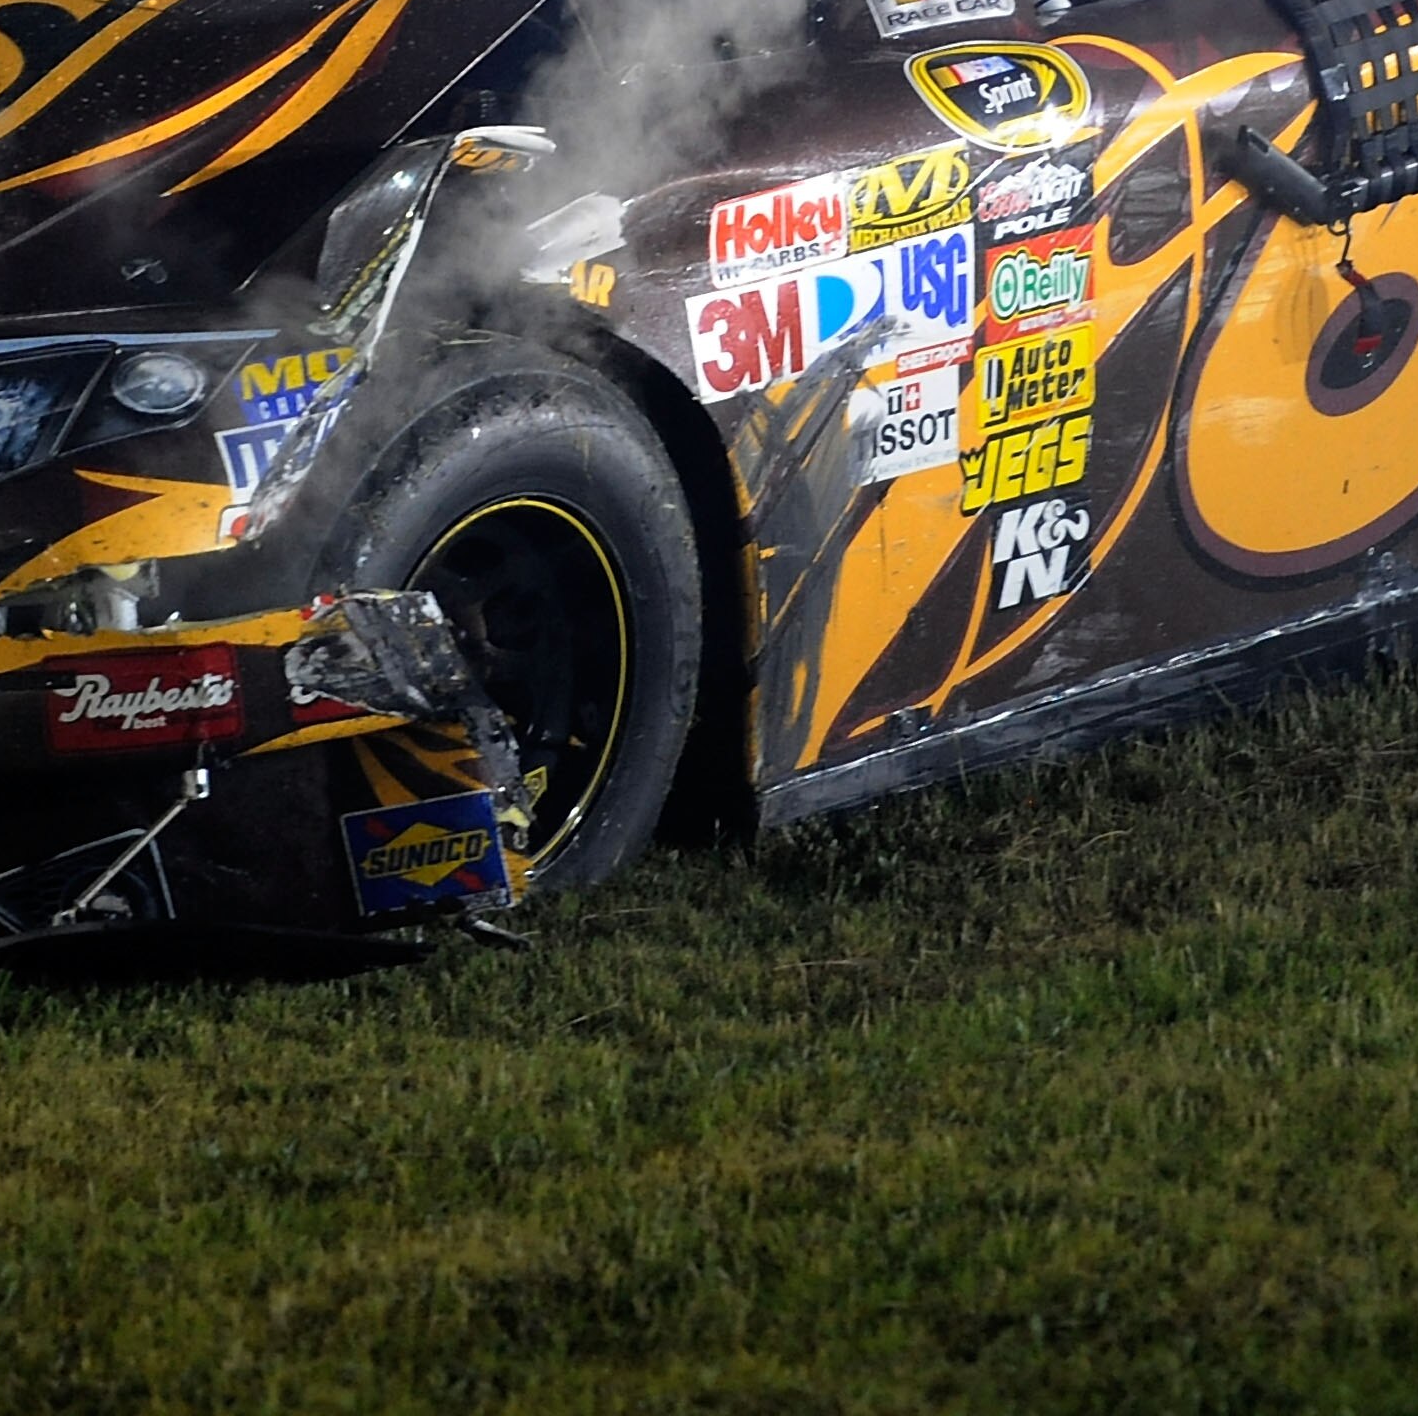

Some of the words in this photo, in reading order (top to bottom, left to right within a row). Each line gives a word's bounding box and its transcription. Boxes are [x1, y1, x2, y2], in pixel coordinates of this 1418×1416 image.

[886, 1, 952, 27] RACE
[978, 72, 1037, 114] Sprint
[715, 192, 843, 264] Holley
[927, 197, 972, 235] WEAR
[993, 206, 1073, 240] POLE
[749, 242, 823, 274] CARBS
[900, 232, 968, 328] USG
[993, 252, 1088, 314] O'Reilly
[698, 279, 804, 393] 3M
[1010, 338, 1072, 379] Auto
[1007, 367, 1086, 412] Meter
[851, 406, 958, 462] TISSOT
[961, 414, 1093, 516] JEGS
[51, 672, 237, 731] Raybestos
[132, 715, 168, 730] best
[366, 829, 488, 879] SUNOCO
